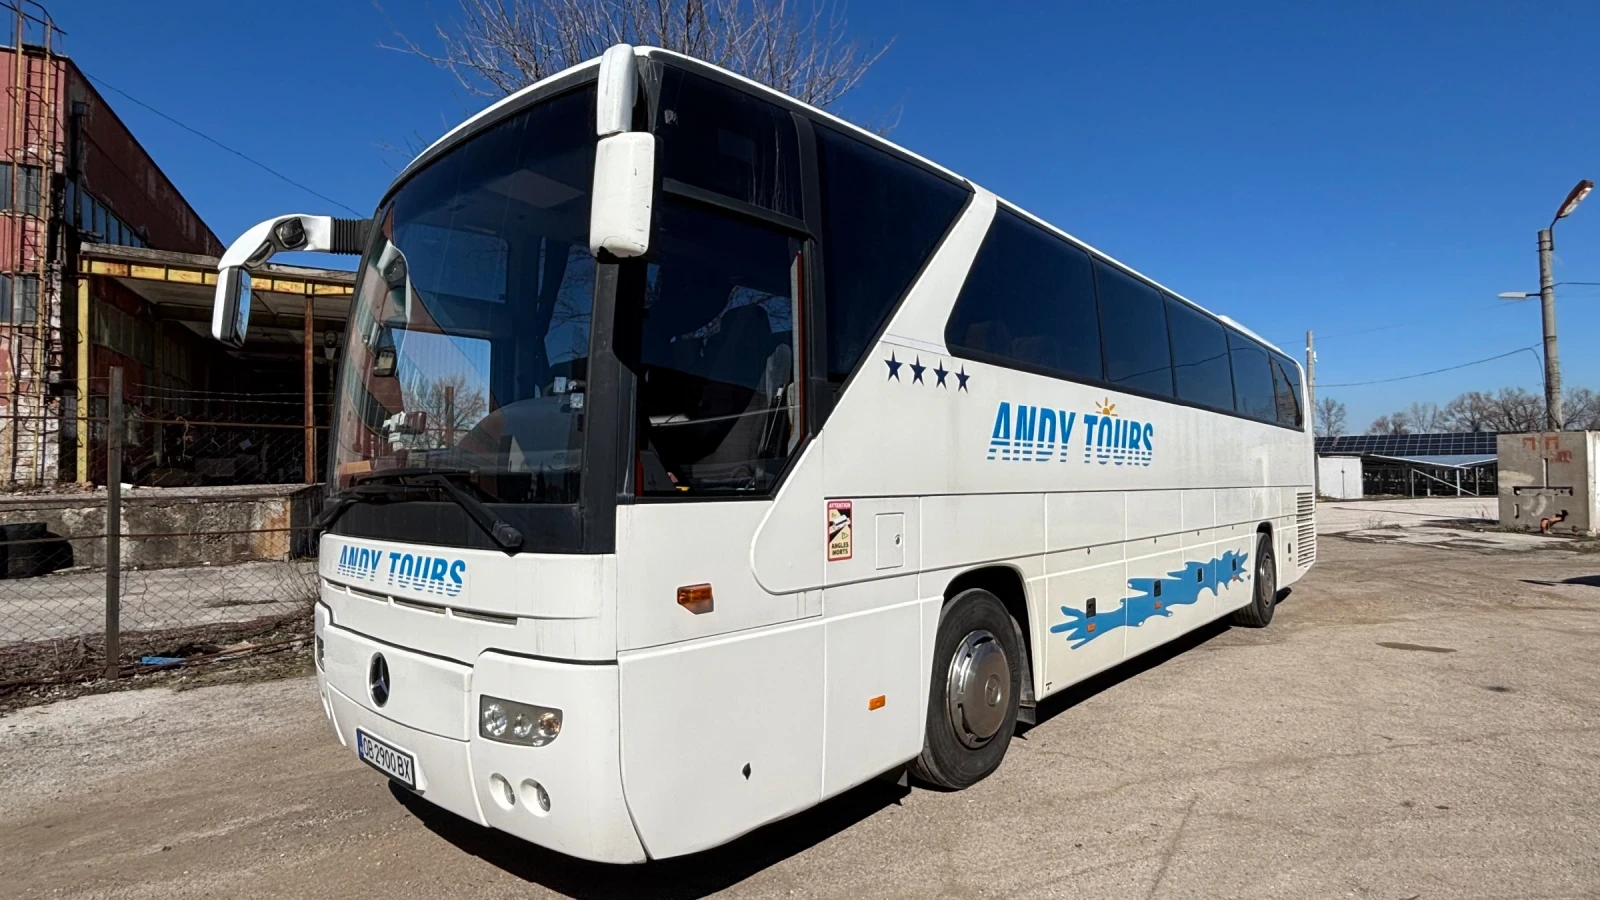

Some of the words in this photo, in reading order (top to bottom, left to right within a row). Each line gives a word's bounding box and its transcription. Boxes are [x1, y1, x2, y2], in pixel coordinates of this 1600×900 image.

[987, 402, 1076, 462] ANDY
[1084, 414, 1153, 466] TOURS
[337, 545, 382, 581] ANDY
[388, 552, 466, 597] TOURS
[832, 548, 848, 556] MORTS
